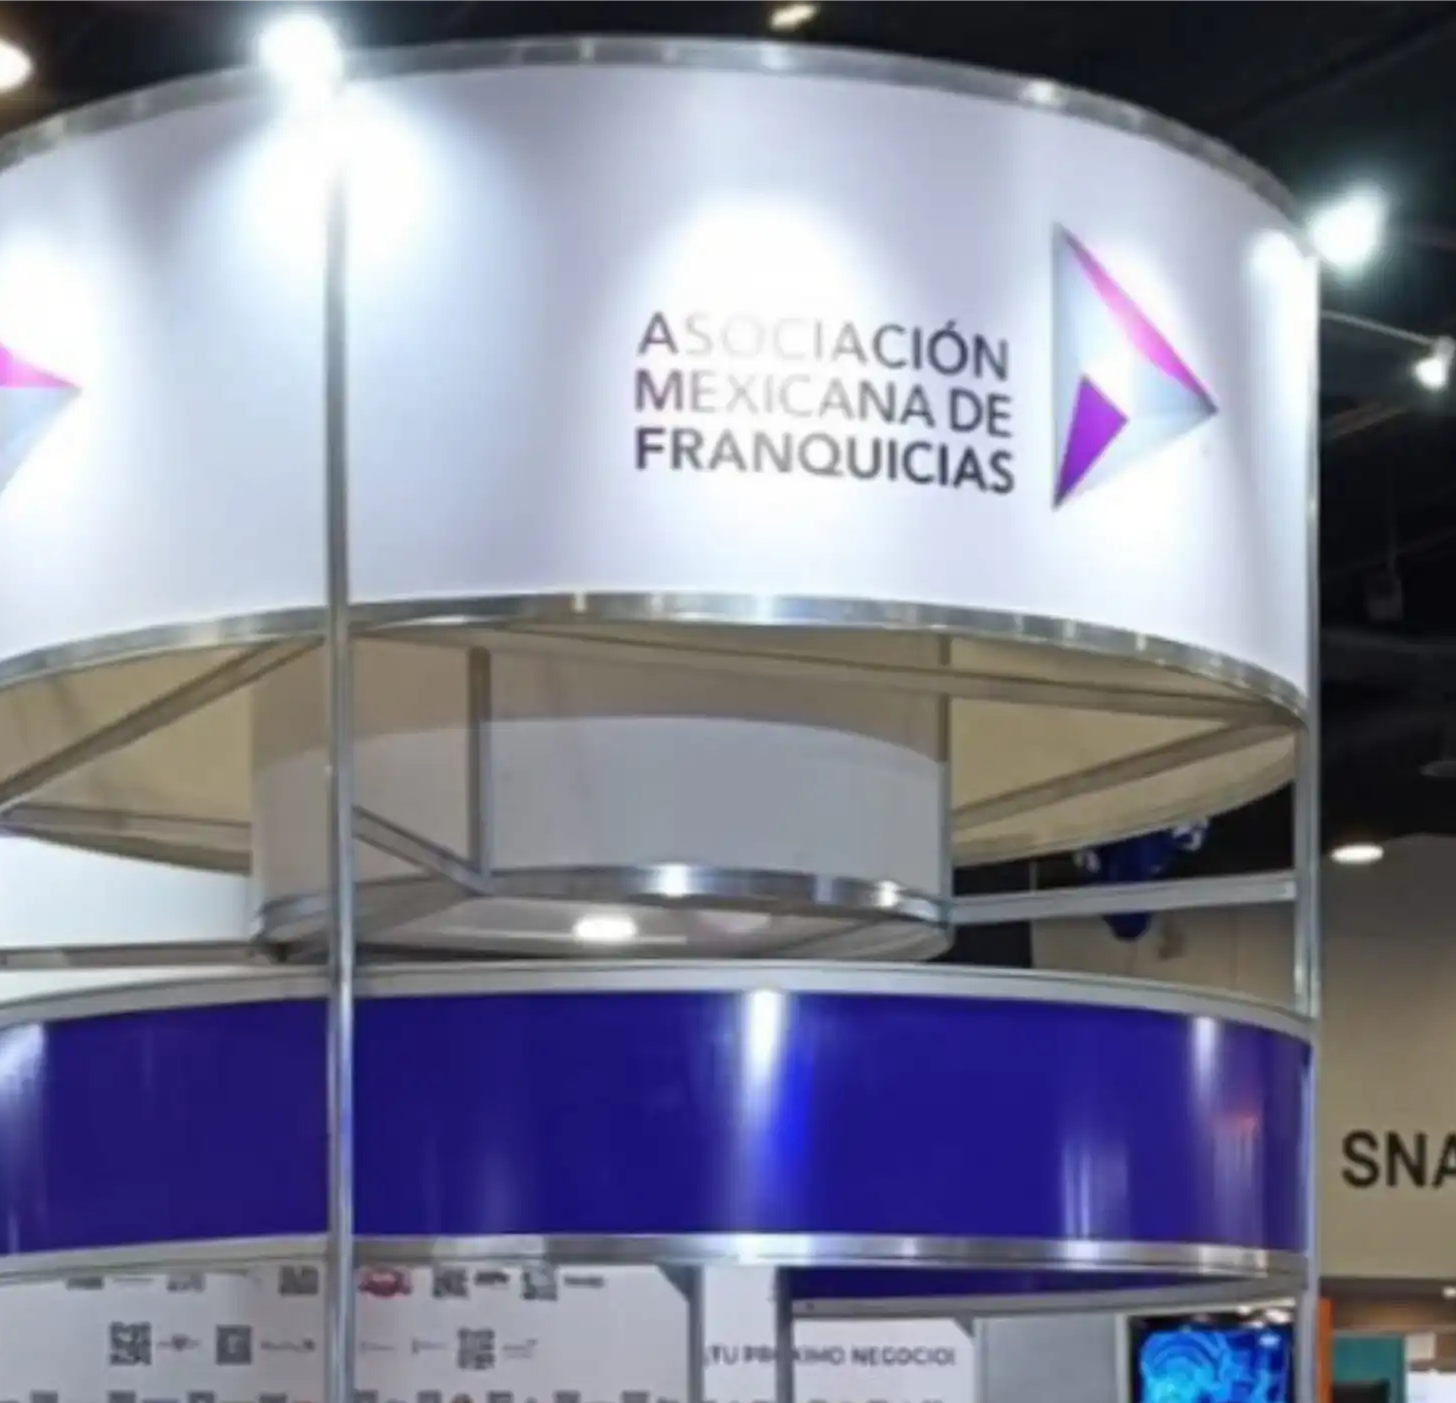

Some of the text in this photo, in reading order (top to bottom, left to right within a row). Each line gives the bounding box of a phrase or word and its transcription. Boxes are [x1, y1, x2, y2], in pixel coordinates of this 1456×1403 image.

[637, 311, 1009, 383] ASOCIACIÓN
[634, 367, 1012, 439] MEXICANA DE
[634, 425, 1015, 495] FRANQUICIAS
[745, 1345, 843, 1366] PRXIMO
